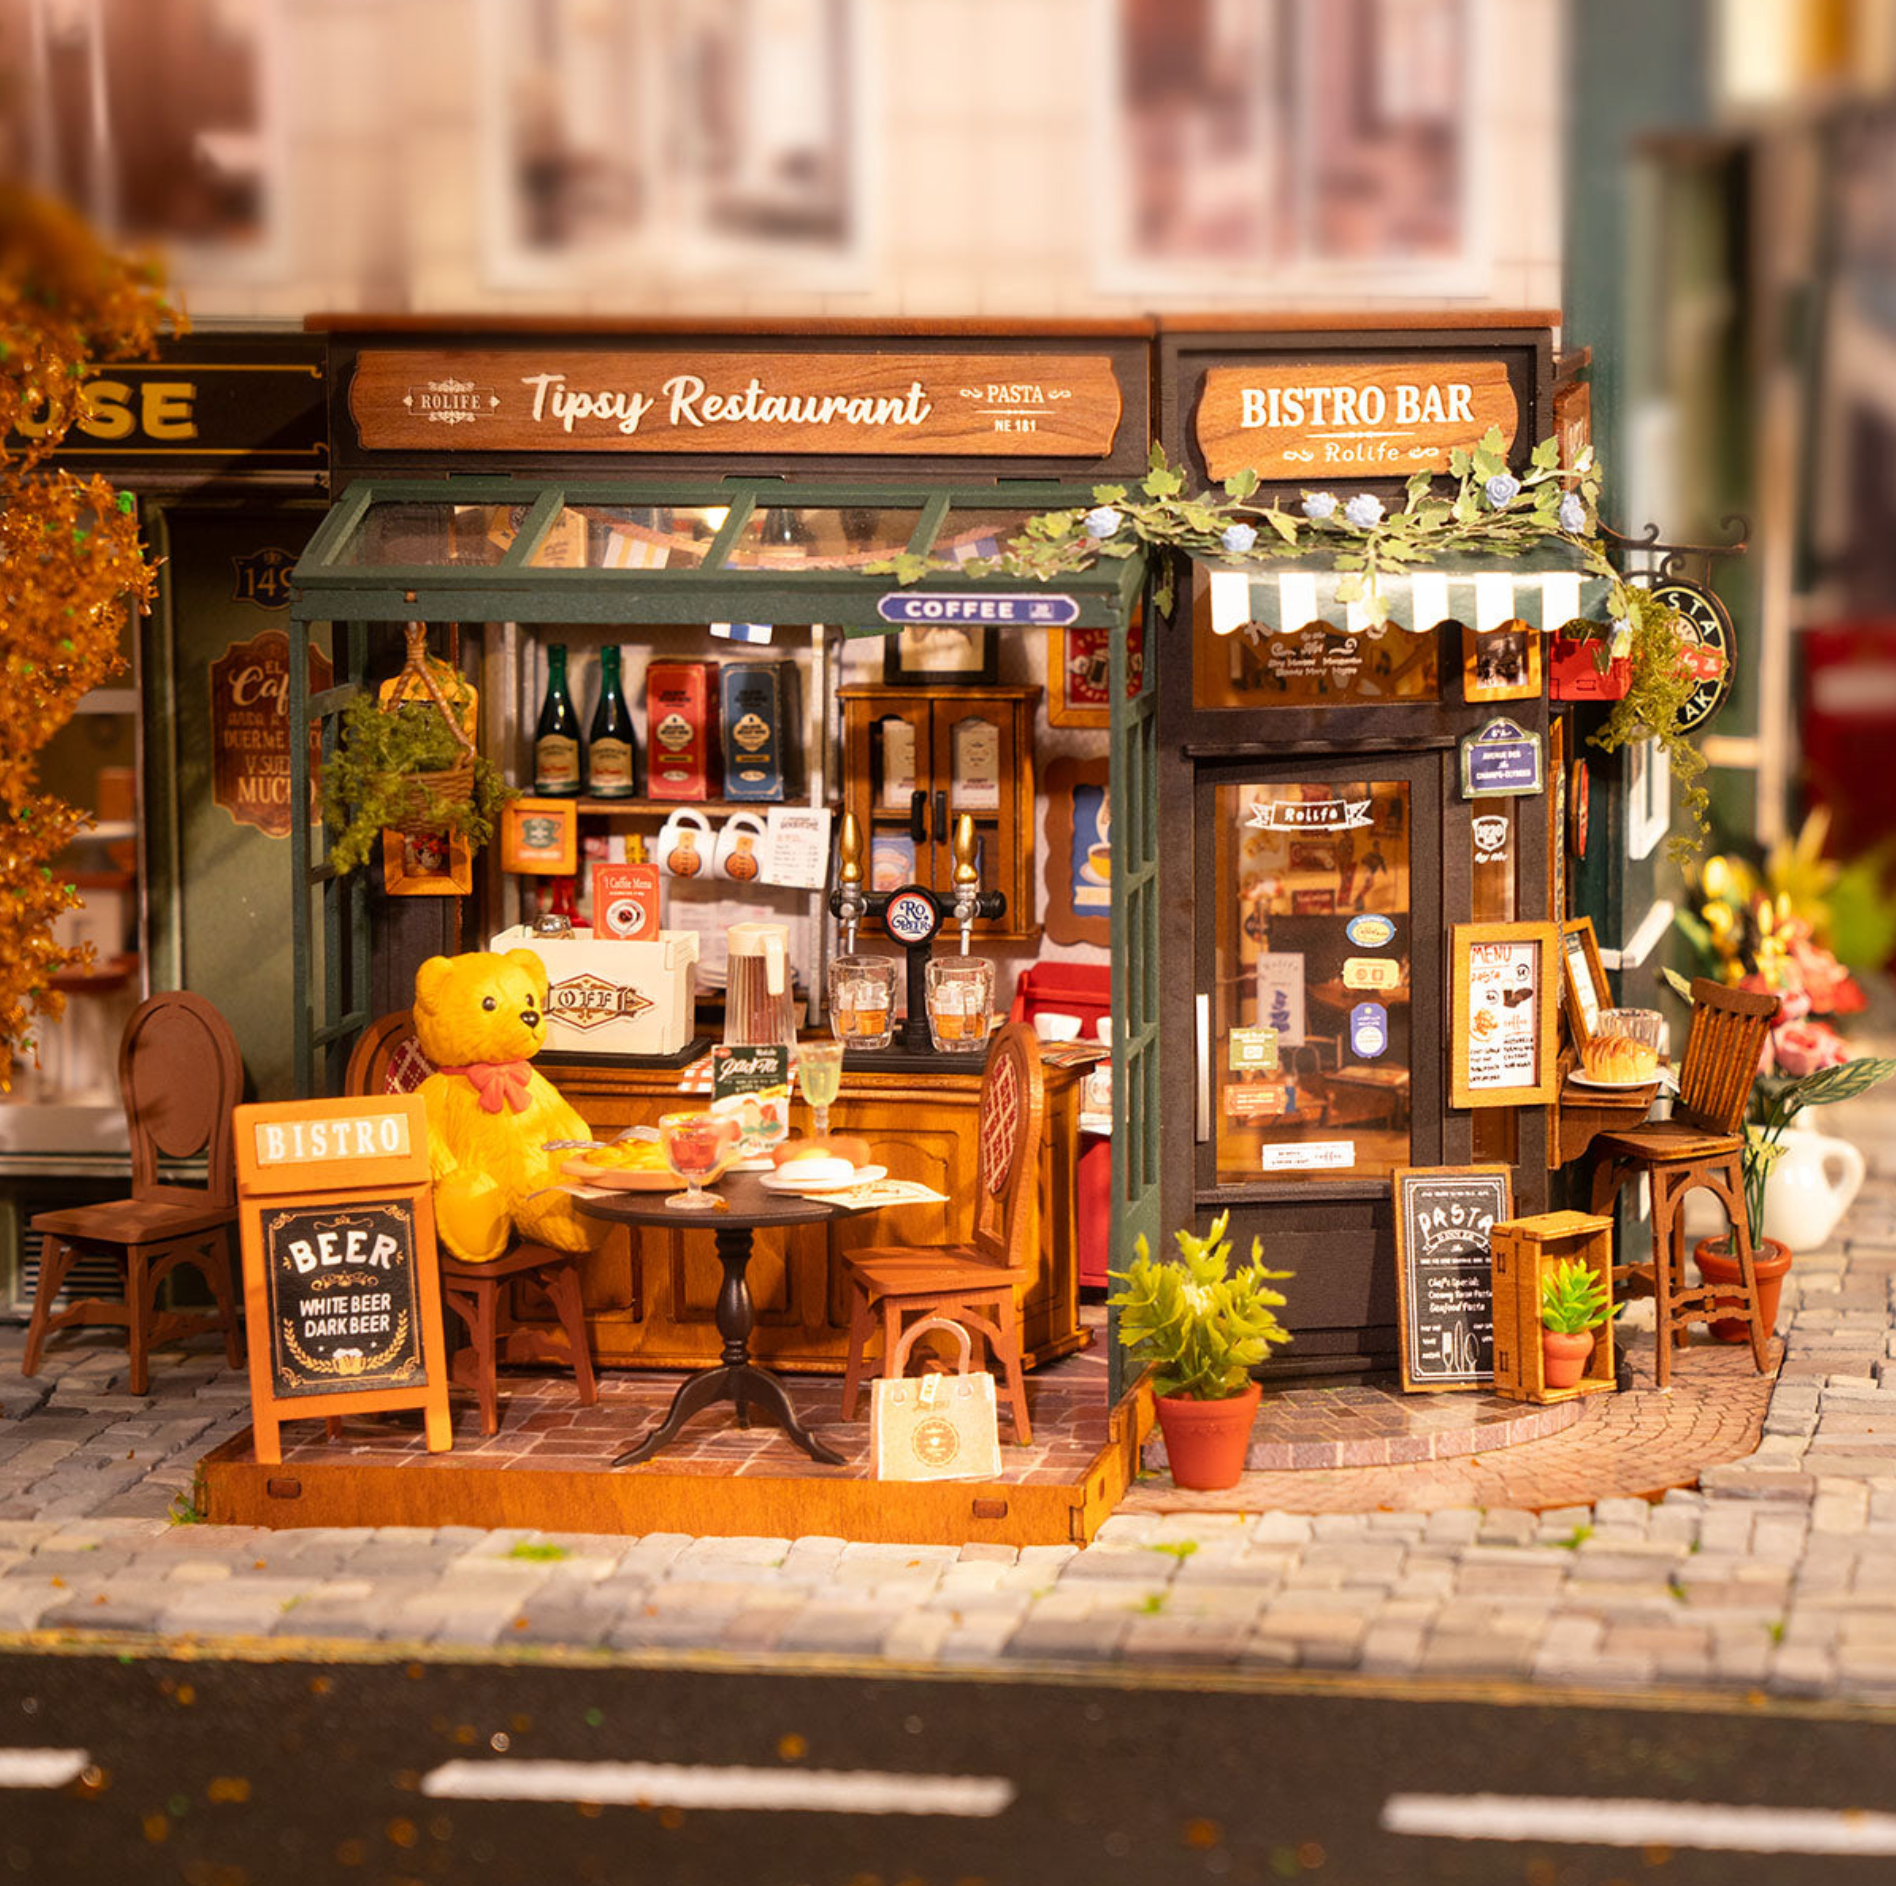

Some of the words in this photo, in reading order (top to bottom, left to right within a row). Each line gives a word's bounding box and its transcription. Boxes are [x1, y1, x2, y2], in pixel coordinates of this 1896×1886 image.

[420, 394, 481, 410] ROLIFE
[521, 373, 654, 434] Tipsy
[662, 374, 931, 429] Restaurant
[986, 384, 1044, 404] PASTA
[1240, 386, 1386, 428] BISTRO
[1395, 384, 1474, 424] BAR
[994, 419, 1012, 432] NE
[1324, 442, 1399, 462] Rolife
[904, 600, 1015, 619] COFFEE
[264, 660, 284, 674] EL
[228, 665, 291, 717] Caf
[1471, 944, 1513, 964] MENU
[265, 1118, 401, 1161] BISTRO
[1418, 1203, 1494, 1241] PASTA
[288, 1230, 399, 1275] BEER
[299, 1296, 349, 1318] WHITE
[350, 1293, 392, 1315] BEER
[304, 1318, 347, 1338] DARK
[349, 1314, 390, 1335] BEER
